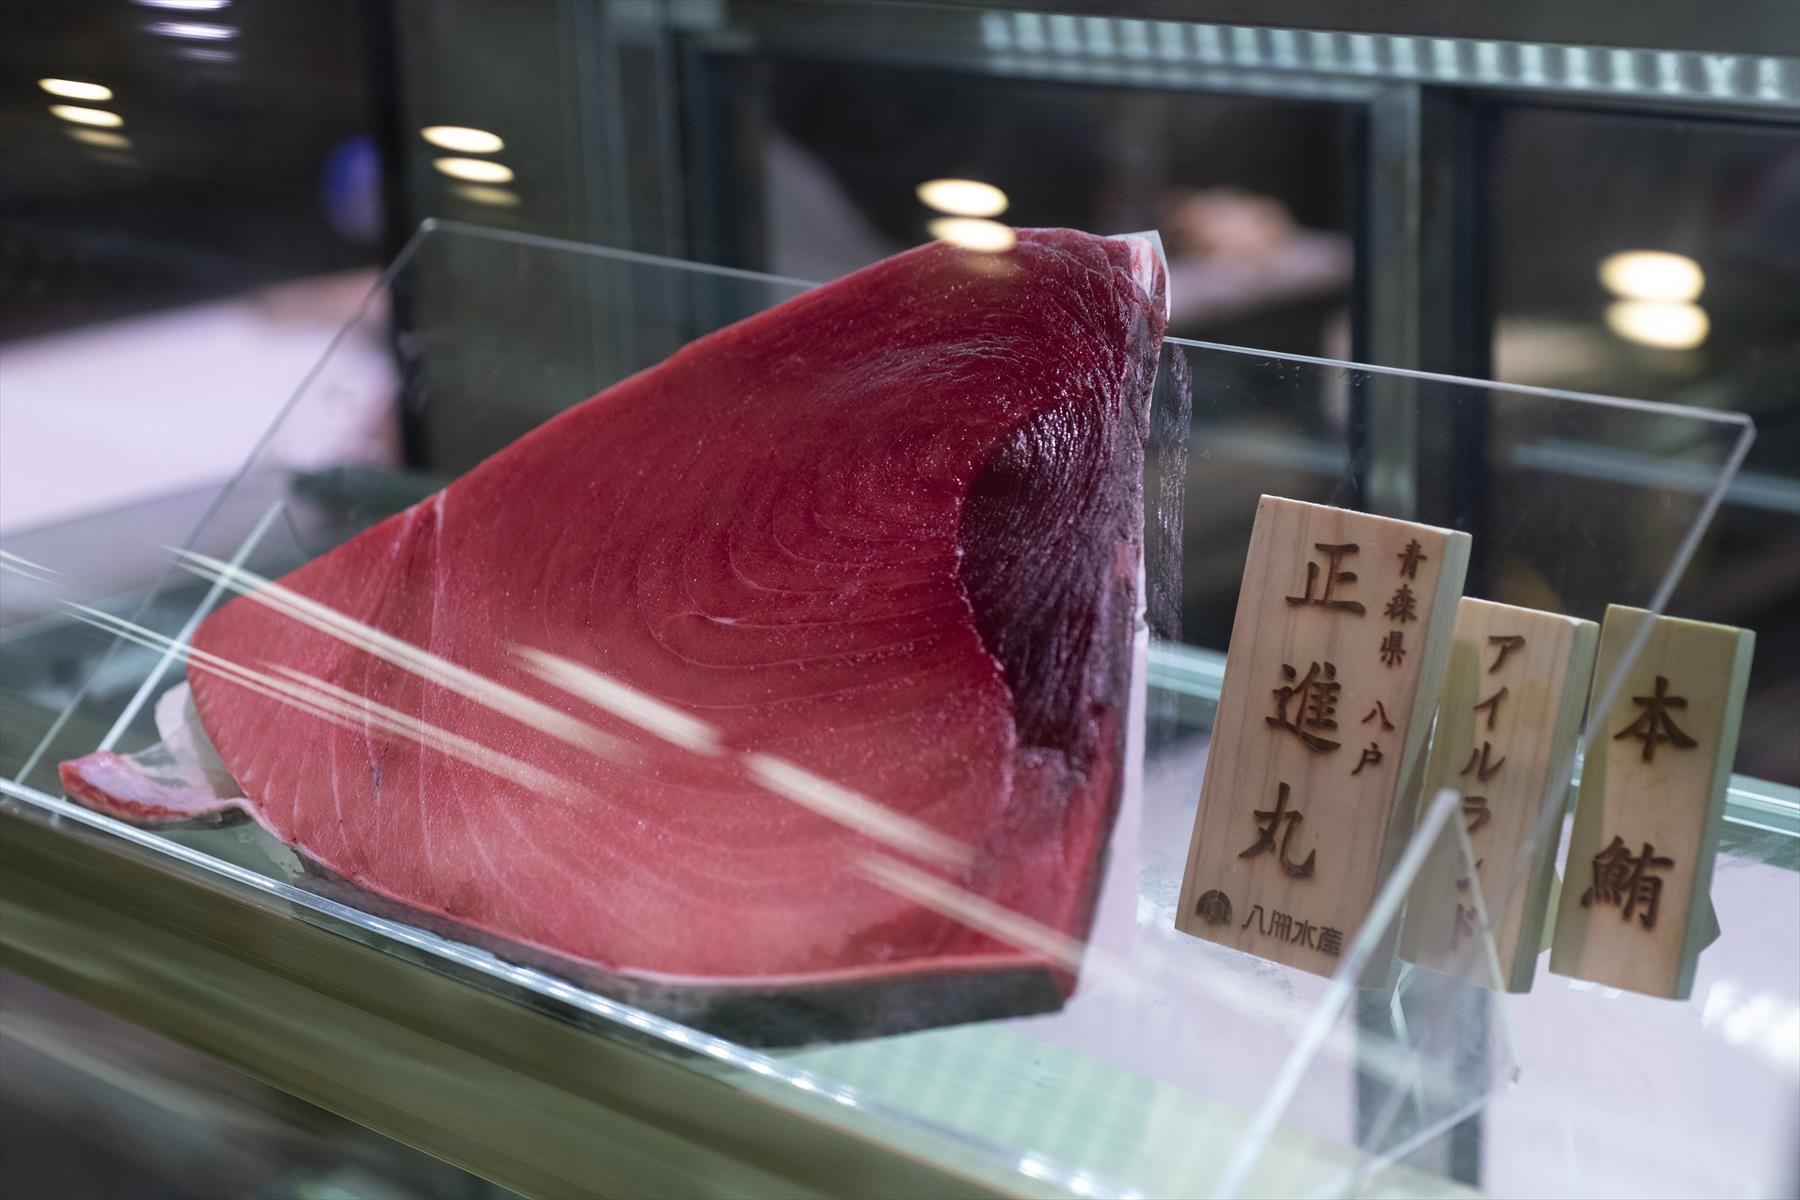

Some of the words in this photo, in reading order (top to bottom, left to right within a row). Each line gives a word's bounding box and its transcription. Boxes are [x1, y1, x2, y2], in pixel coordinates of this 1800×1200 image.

[1379, 538, 1428, 669] 青森県
[1238, 542, 1367, 879] 正進丸
[1351, 700, 1396, 776] 八戸
[1580, 674, 1699, 931] 本鮪
